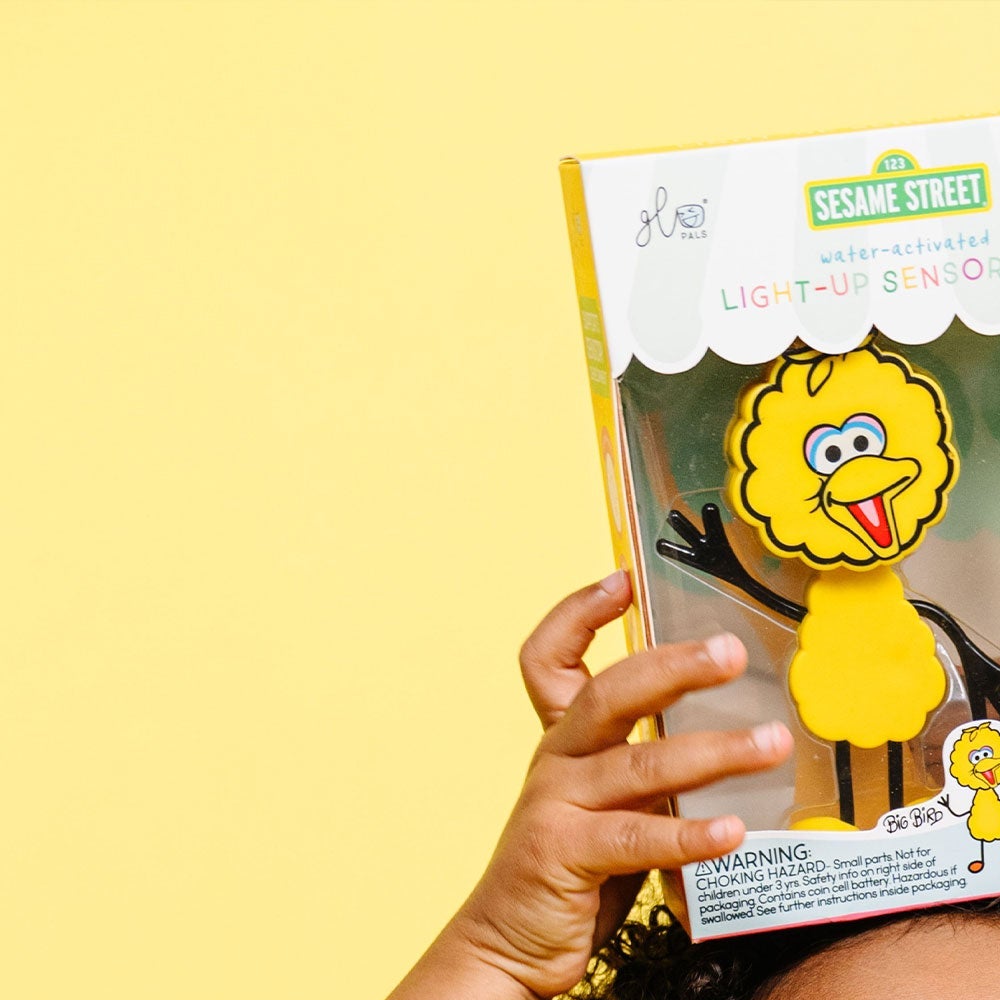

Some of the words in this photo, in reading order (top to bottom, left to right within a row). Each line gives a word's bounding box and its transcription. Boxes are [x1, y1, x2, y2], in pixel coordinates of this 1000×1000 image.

[884, 157, 906, 171] 123
[814, 182, 900, 221] SESAME
[904, 173, 981, 211] STREET
[681, 230, 707, 239] PALS
[820, 229, 990, 264] water-activated
[722, 272, 869, 310] LIGHT-UP
[696, 869, 764, 890] CHOKING
[833, 856, 862, 870] Small
[895, 848, 914, 860] Not
[916, 847, 931, 858] for
[711, 844, 812, 873] WARNING:
[698, 888, 740, 902] children
[742, 882, 773, 896] under
[775, 880, 783, 891] 3
[803, 871, 837, 887] Safety
[839, 869, 858, 880] info
[861, 869, 875, 878] on
[876, 862, 900, 877] right
[903, 860, 923, 871] side
[925, 856, 936, 868] of
[758, 890, 806, 904] Contains
[808, 885, 830, 897] coin
[832, 881, 849, 893] cell
[892, 869, 949, 884] Hazardous
[951, 864, 958, 875] if
[756, 905, 777, 917] See
[779, 898, 815, 913] further
[817, 889, 878, 907] instructions
[880, 884, 910, 897] inside
